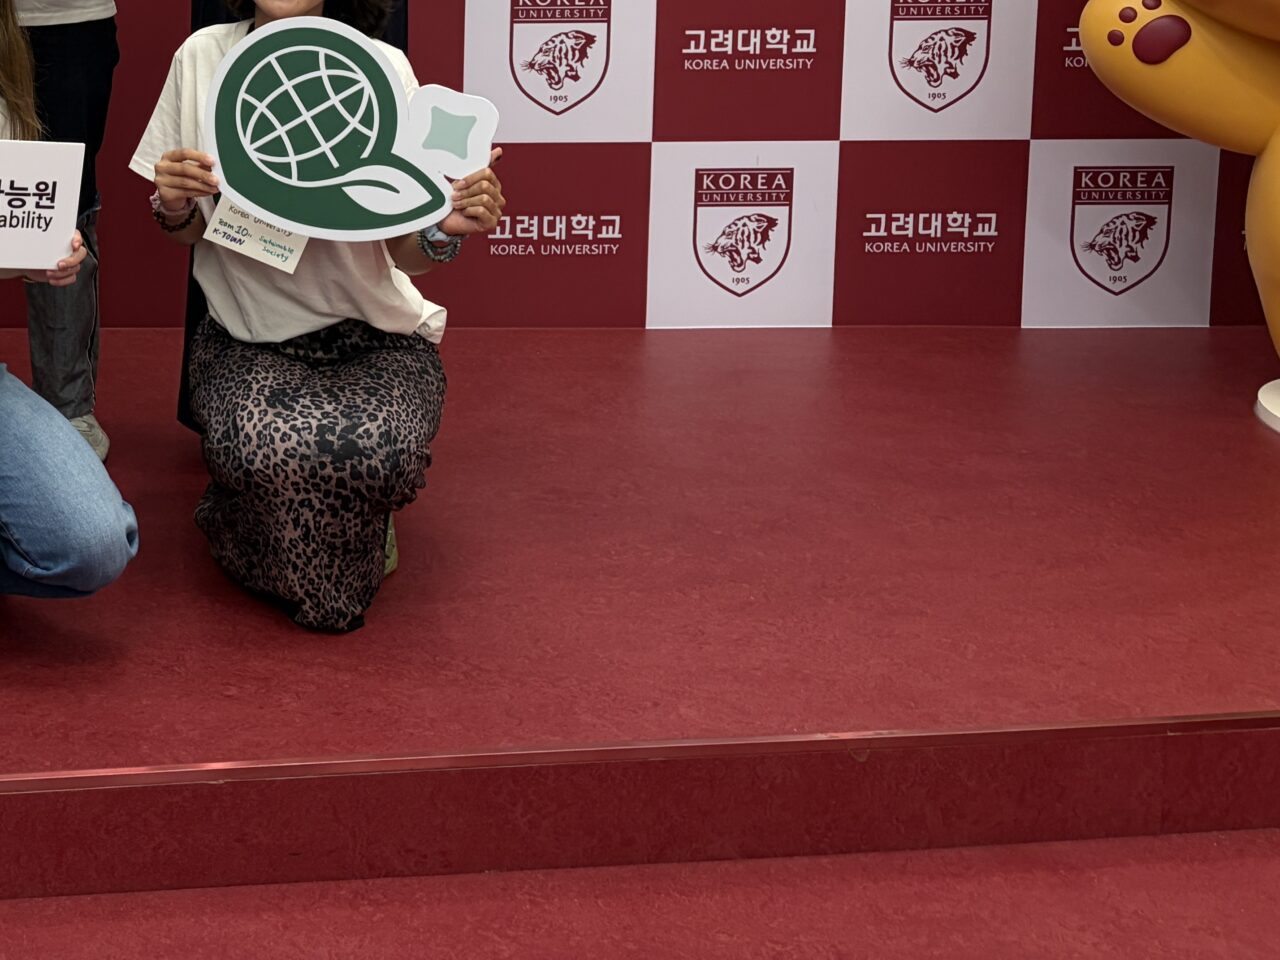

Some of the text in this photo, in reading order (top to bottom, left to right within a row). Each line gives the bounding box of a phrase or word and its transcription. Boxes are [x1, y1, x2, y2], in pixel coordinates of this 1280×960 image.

[519, 9, 605, 19] UNIVERSITY
[898, 6, 986, 17] UNIVERSITY
[681, 27, 817, 55] 고려대학교
[684, 58, 814, 70] KOREA UNIVERSITY
[549, 93, 569, 104] 1905
[927, 91, 948, 102] 1905
[702, 173, 787, 190] KOREA
[1081, 172, 1166, 188] KOREA
[702, 193, 788, 203] UNIVERSITY
[1081, 190, 1167, 201] UNIVERSITY
[228, 205, 250, 220] Korea
[487, 213, 623, 241] 고려대학교
[862, 211, 998, 238] 고려대학교
[490, 244, 620, 256] KOREA UNIVERSITY
[864, 241, 995, 253] KOREA UNIVERSITY
[731, 276, 751, 286] 1905
[1108, 275, 1128, 285] 1905
